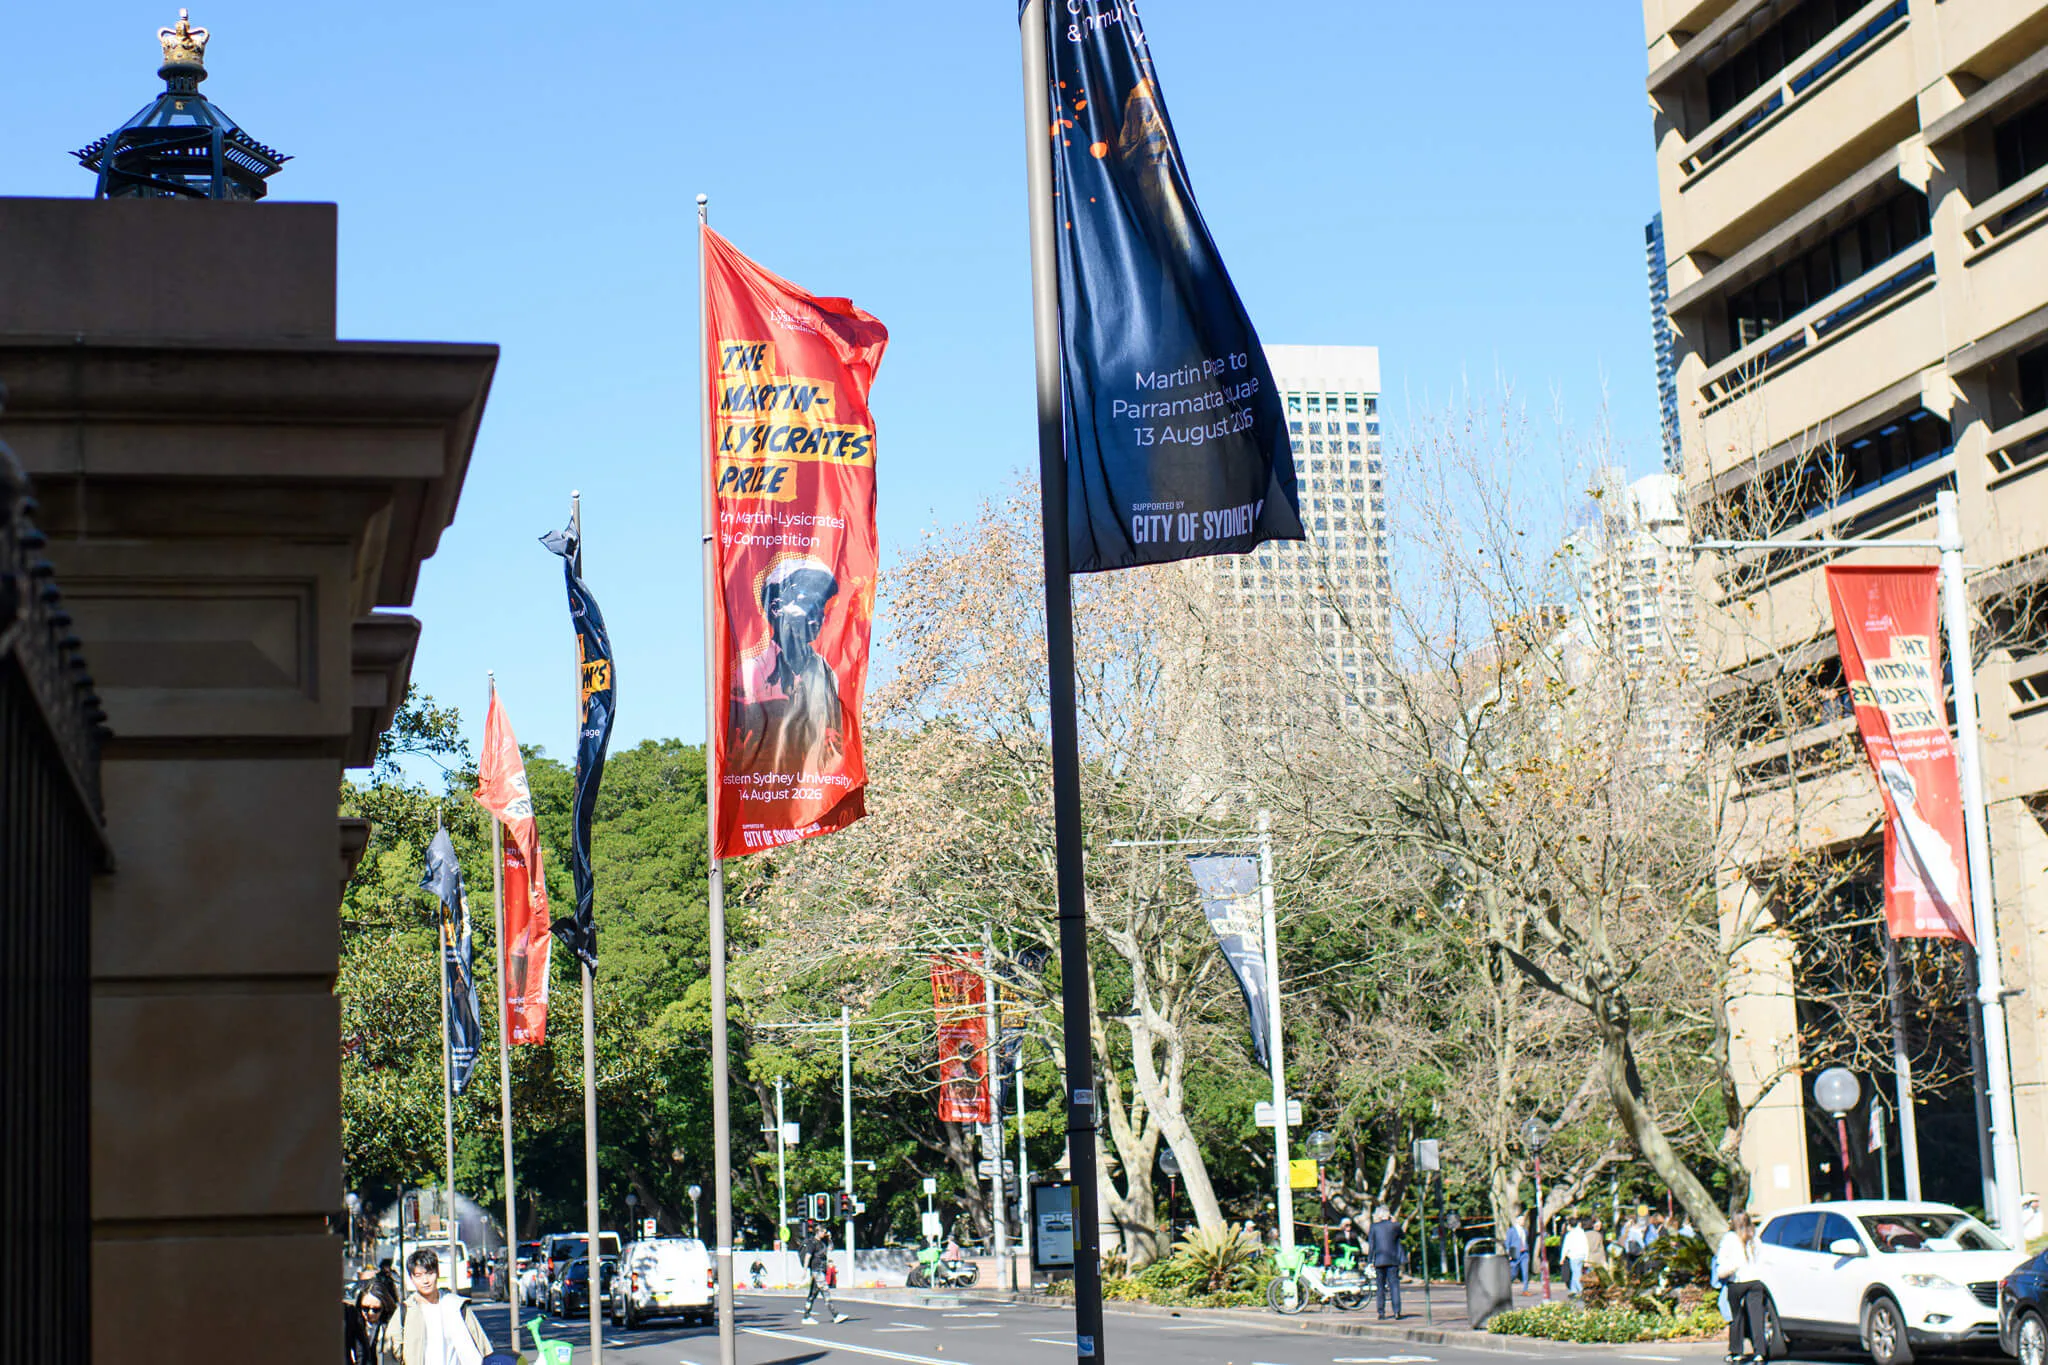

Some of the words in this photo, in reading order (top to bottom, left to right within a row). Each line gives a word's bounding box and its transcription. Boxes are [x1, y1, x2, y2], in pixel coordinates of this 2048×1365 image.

[722, 343, 767, 371] THE
[1135, 364, 1200, 391] Martin
[1228, 352, 1248, 370] to
[720, 383, 830, 413] MARTIN-
[1113, 391, 1224, 419] Parramatta
[719, 424, 873, 460] LYSICRATES
[1133, 427, 1155, 447] 13
[1159, 415, 1230, 446] August
[718, 465, 789, 494] PRIZE
[735, 510, 845, 530] Martin-Lysicrates
[1132, 501, 1174, 512] SUPPORTED
[1175, 500, 1185, 510] BY
[1132, 513, 1173, 544] CITY
[1177, 511, 1199, 543] OF
[1202, 503, 1254, 541] SYDNEY
[734, 531, 821, 549] Competition
[753, 771, 795, 787] Sydney
[796, 771, 853, 790] University
[738, 789, 750, 801] 14
[750, 788, 790, 803] August
[791, 787, 823, 800] 2026
[743, 830, 763, 848] CITY
[762, 829, 775, 846] OF
